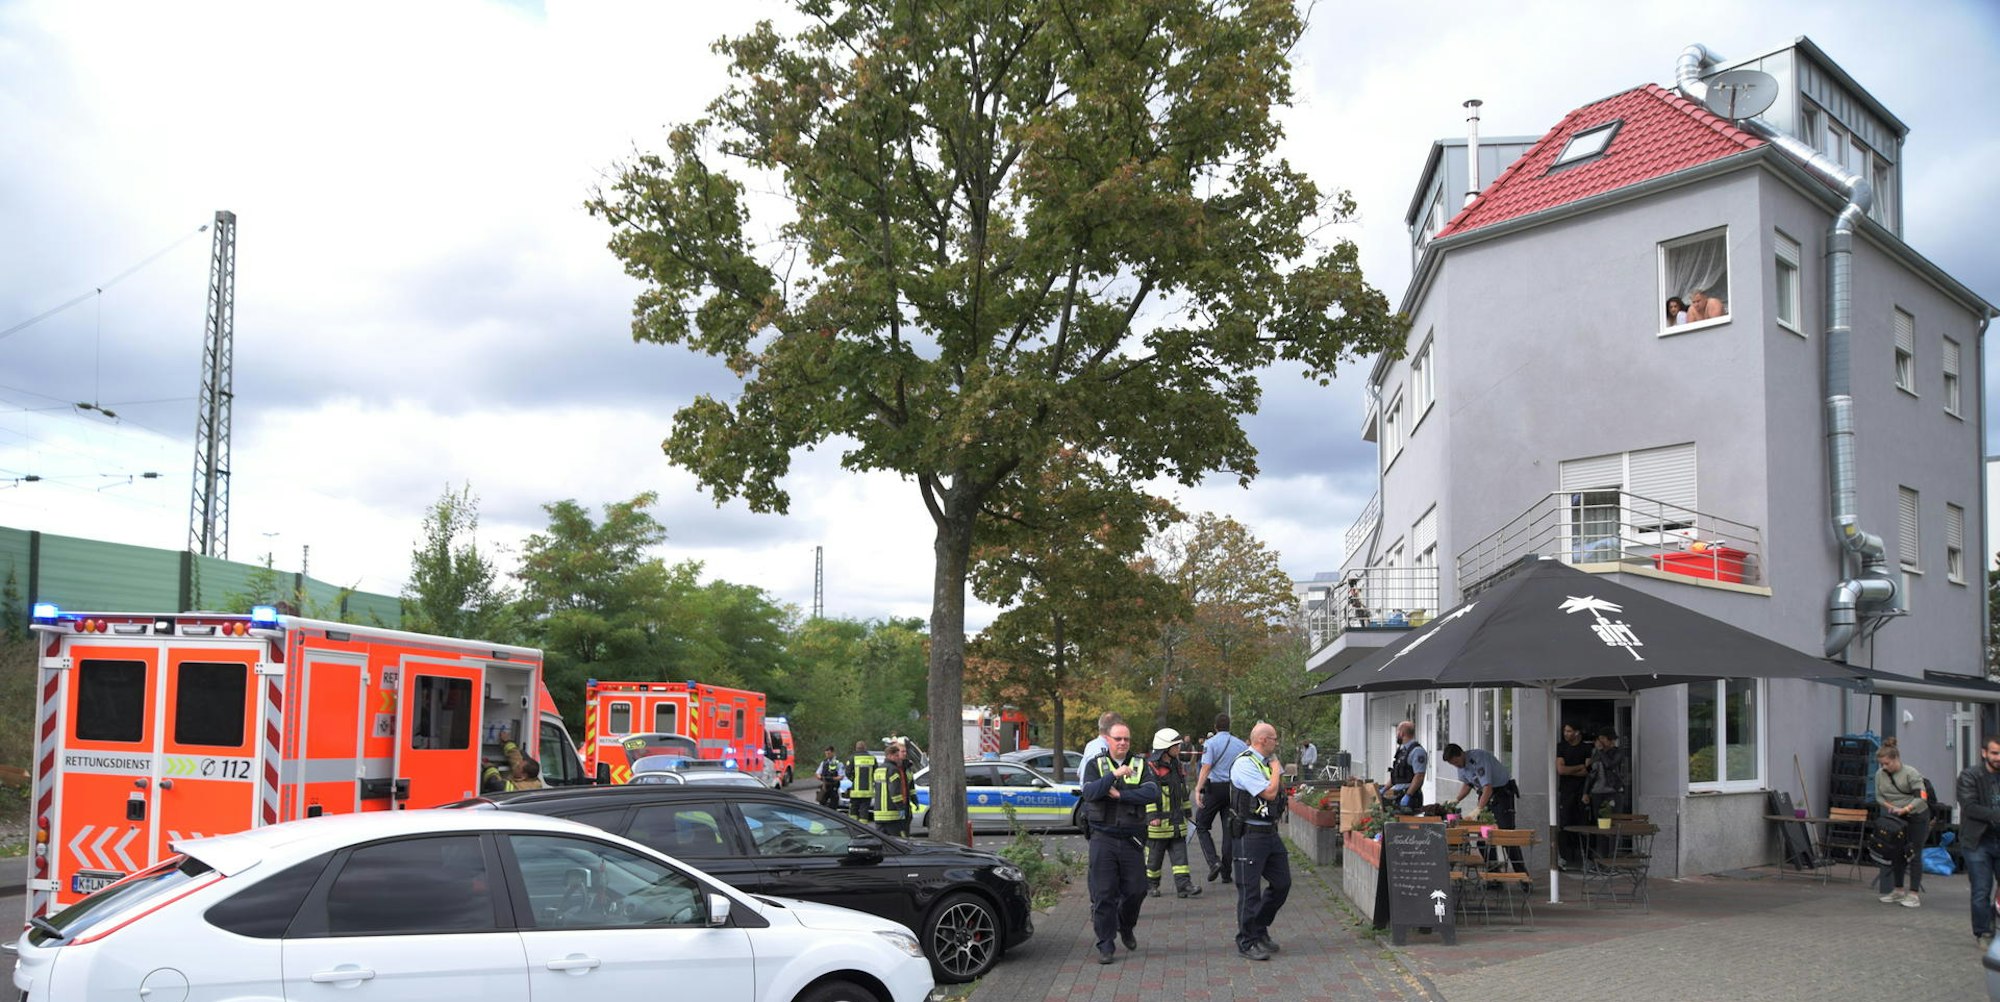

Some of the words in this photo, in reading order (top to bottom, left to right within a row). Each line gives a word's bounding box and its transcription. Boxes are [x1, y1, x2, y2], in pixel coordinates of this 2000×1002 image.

[65, 756, 151, 770] RETTUNGSDIENST
[222, 760, 250, 778] 112
[1017, 795, 1057, 805] POLIZEI
[79, 878, 85, 889] K
